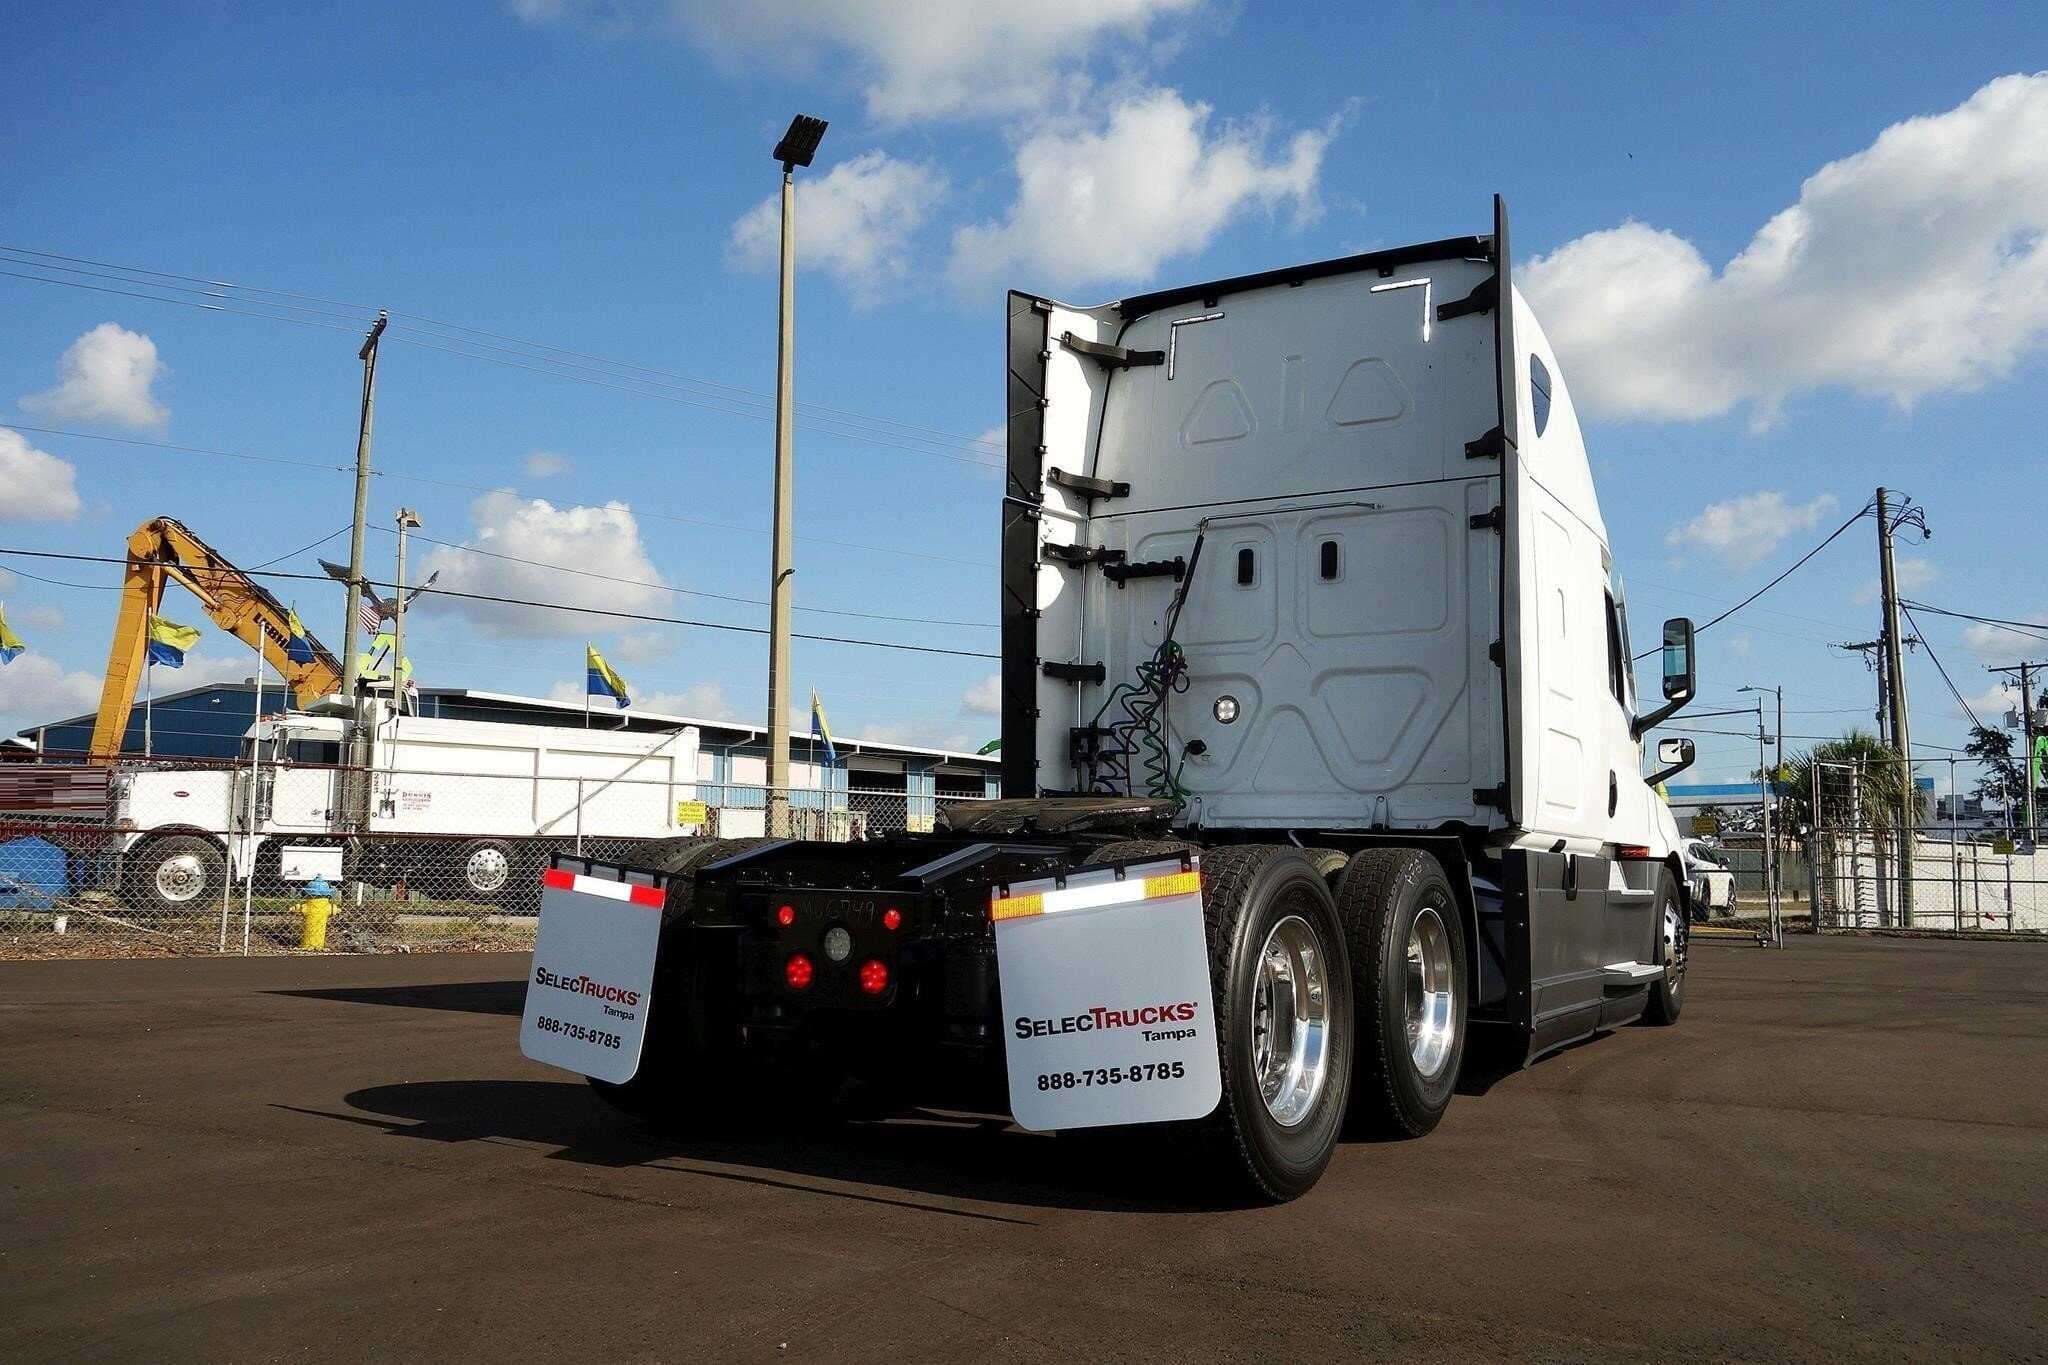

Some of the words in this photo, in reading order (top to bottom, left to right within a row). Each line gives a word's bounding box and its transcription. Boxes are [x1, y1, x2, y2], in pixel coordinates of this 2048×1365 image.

[603, 1005, 634, 1020] Tampa
[538, 1016, 620, 1049] 888-735-8785
[1142, 1028, 1196, 1042] Tampa
[1037, 1061, 1185, 1091] 888-735-8785
